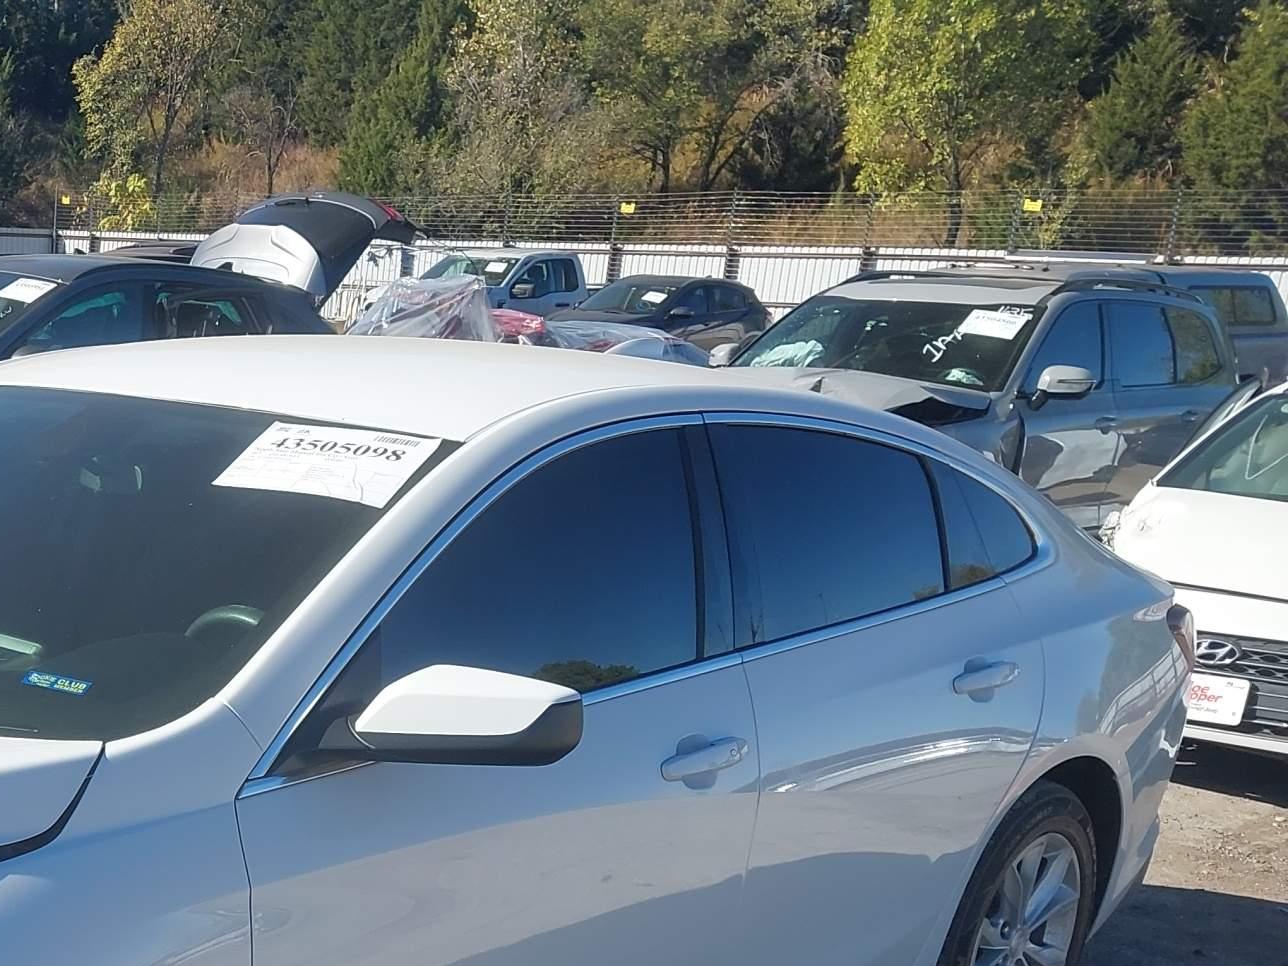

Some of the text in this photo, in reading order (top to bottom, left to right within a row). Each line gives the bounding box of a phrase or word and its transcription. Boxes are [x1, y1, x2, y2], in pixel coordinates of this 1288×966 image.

[270, 436, 407, 463] 43505098
[57, 678, 88, 690] CLUB
[1190, 682, 1210, 694] oe
